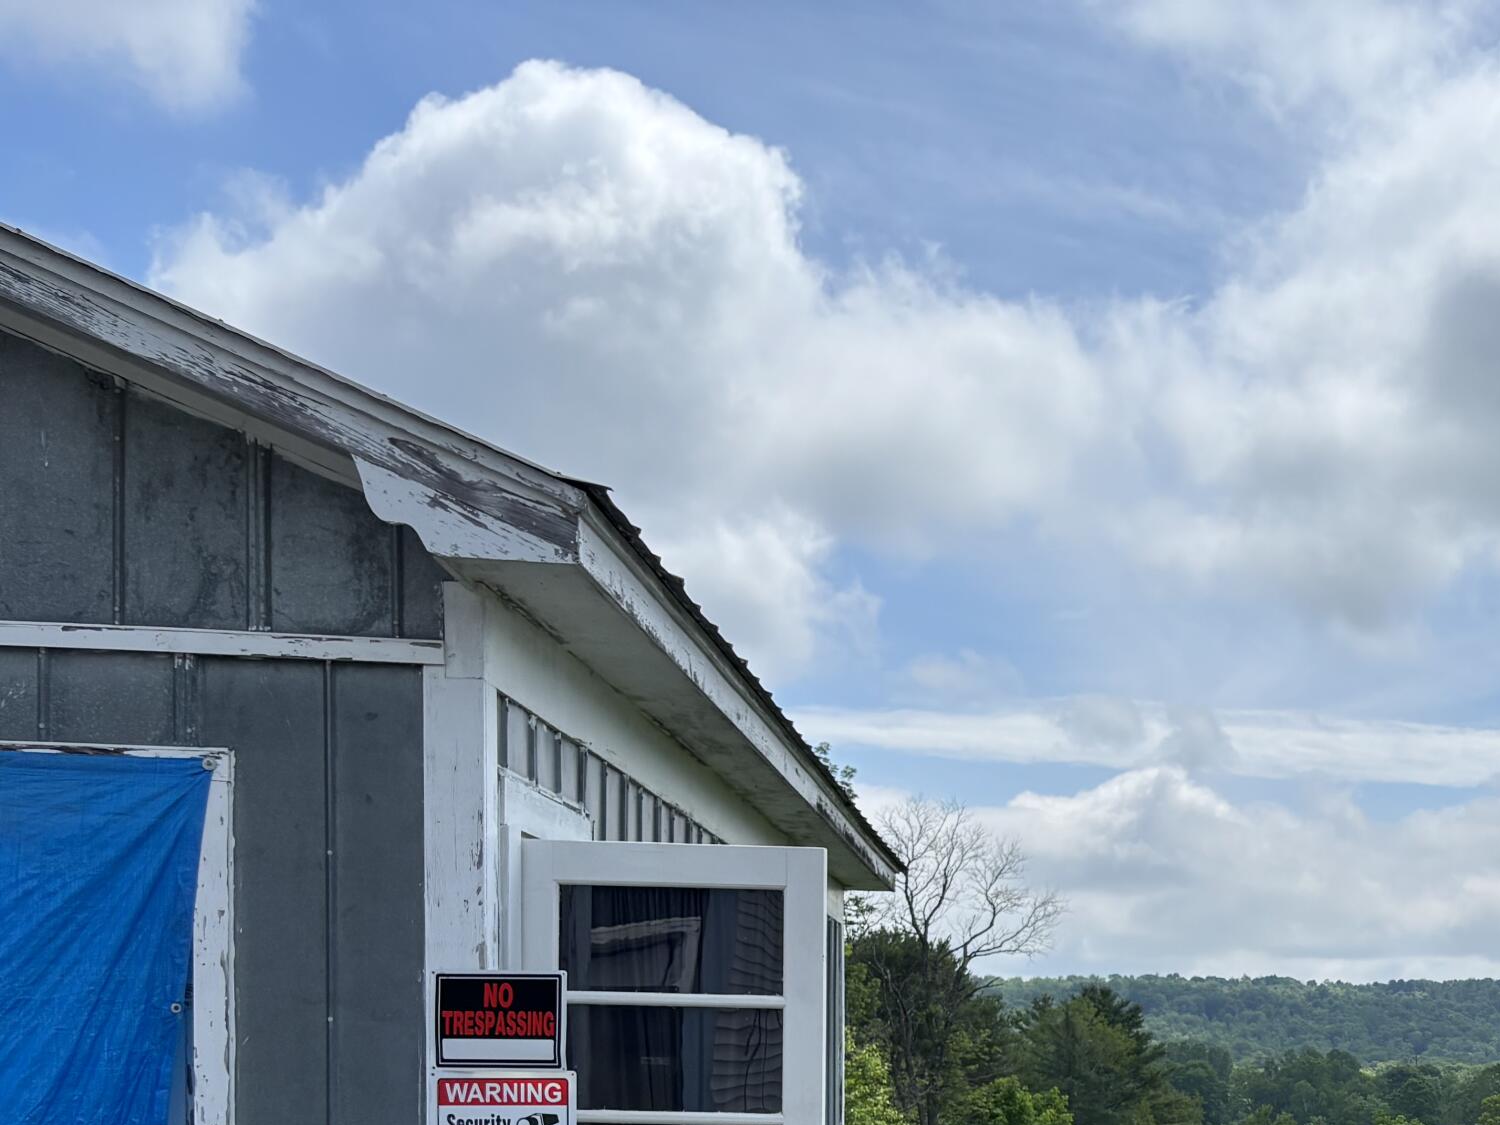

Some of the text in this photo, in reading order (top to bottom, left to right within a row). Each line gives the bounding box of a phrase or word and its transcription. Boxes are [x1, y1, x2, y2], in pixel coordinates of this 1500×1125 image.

[483, 982, 514, 1008] NO
[441, 1010, 556, 1037] TRESPASSING
[445, 1082, 563, 1103] WARNING
